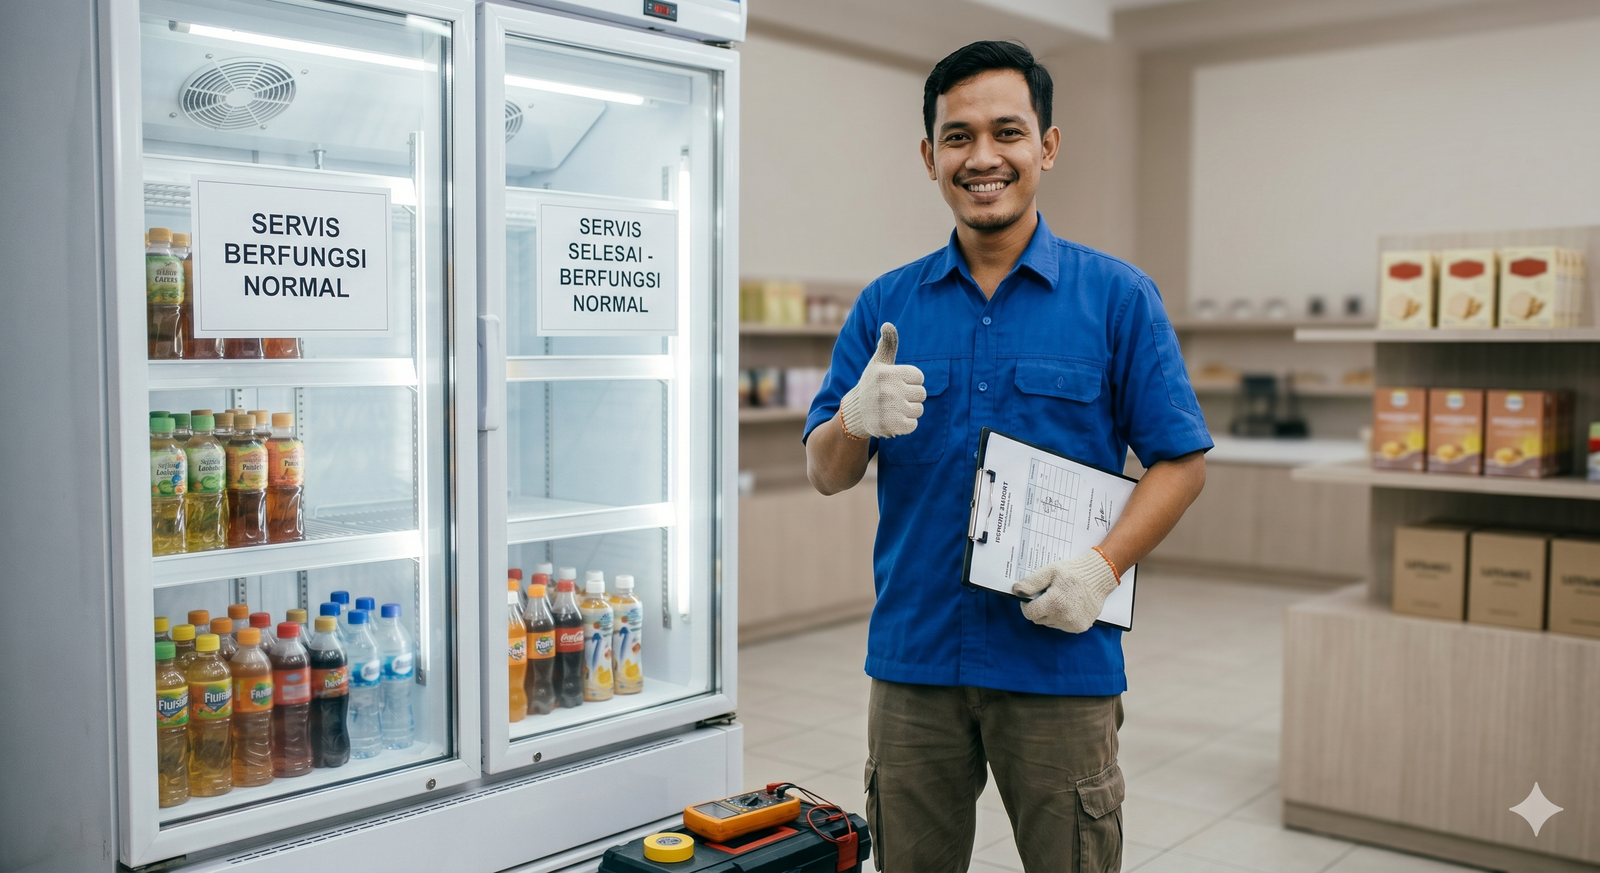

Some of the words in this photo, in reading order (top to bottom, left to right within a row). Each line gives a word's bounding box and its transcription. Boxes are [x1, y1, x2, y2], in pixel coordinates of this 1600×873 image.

[252, 213, 340, 238] SERVIS
[579, 217, 642, 238] SERVIS
[224, 243, 366, 269] BERFUNGSI
[568, 242, 642, 263] SELESAI
[244, 275, 350, 298] NORMAL
[560, 268, 661, 289] BERFUNGSI
[573, 294, 649, 313] NORMAL
